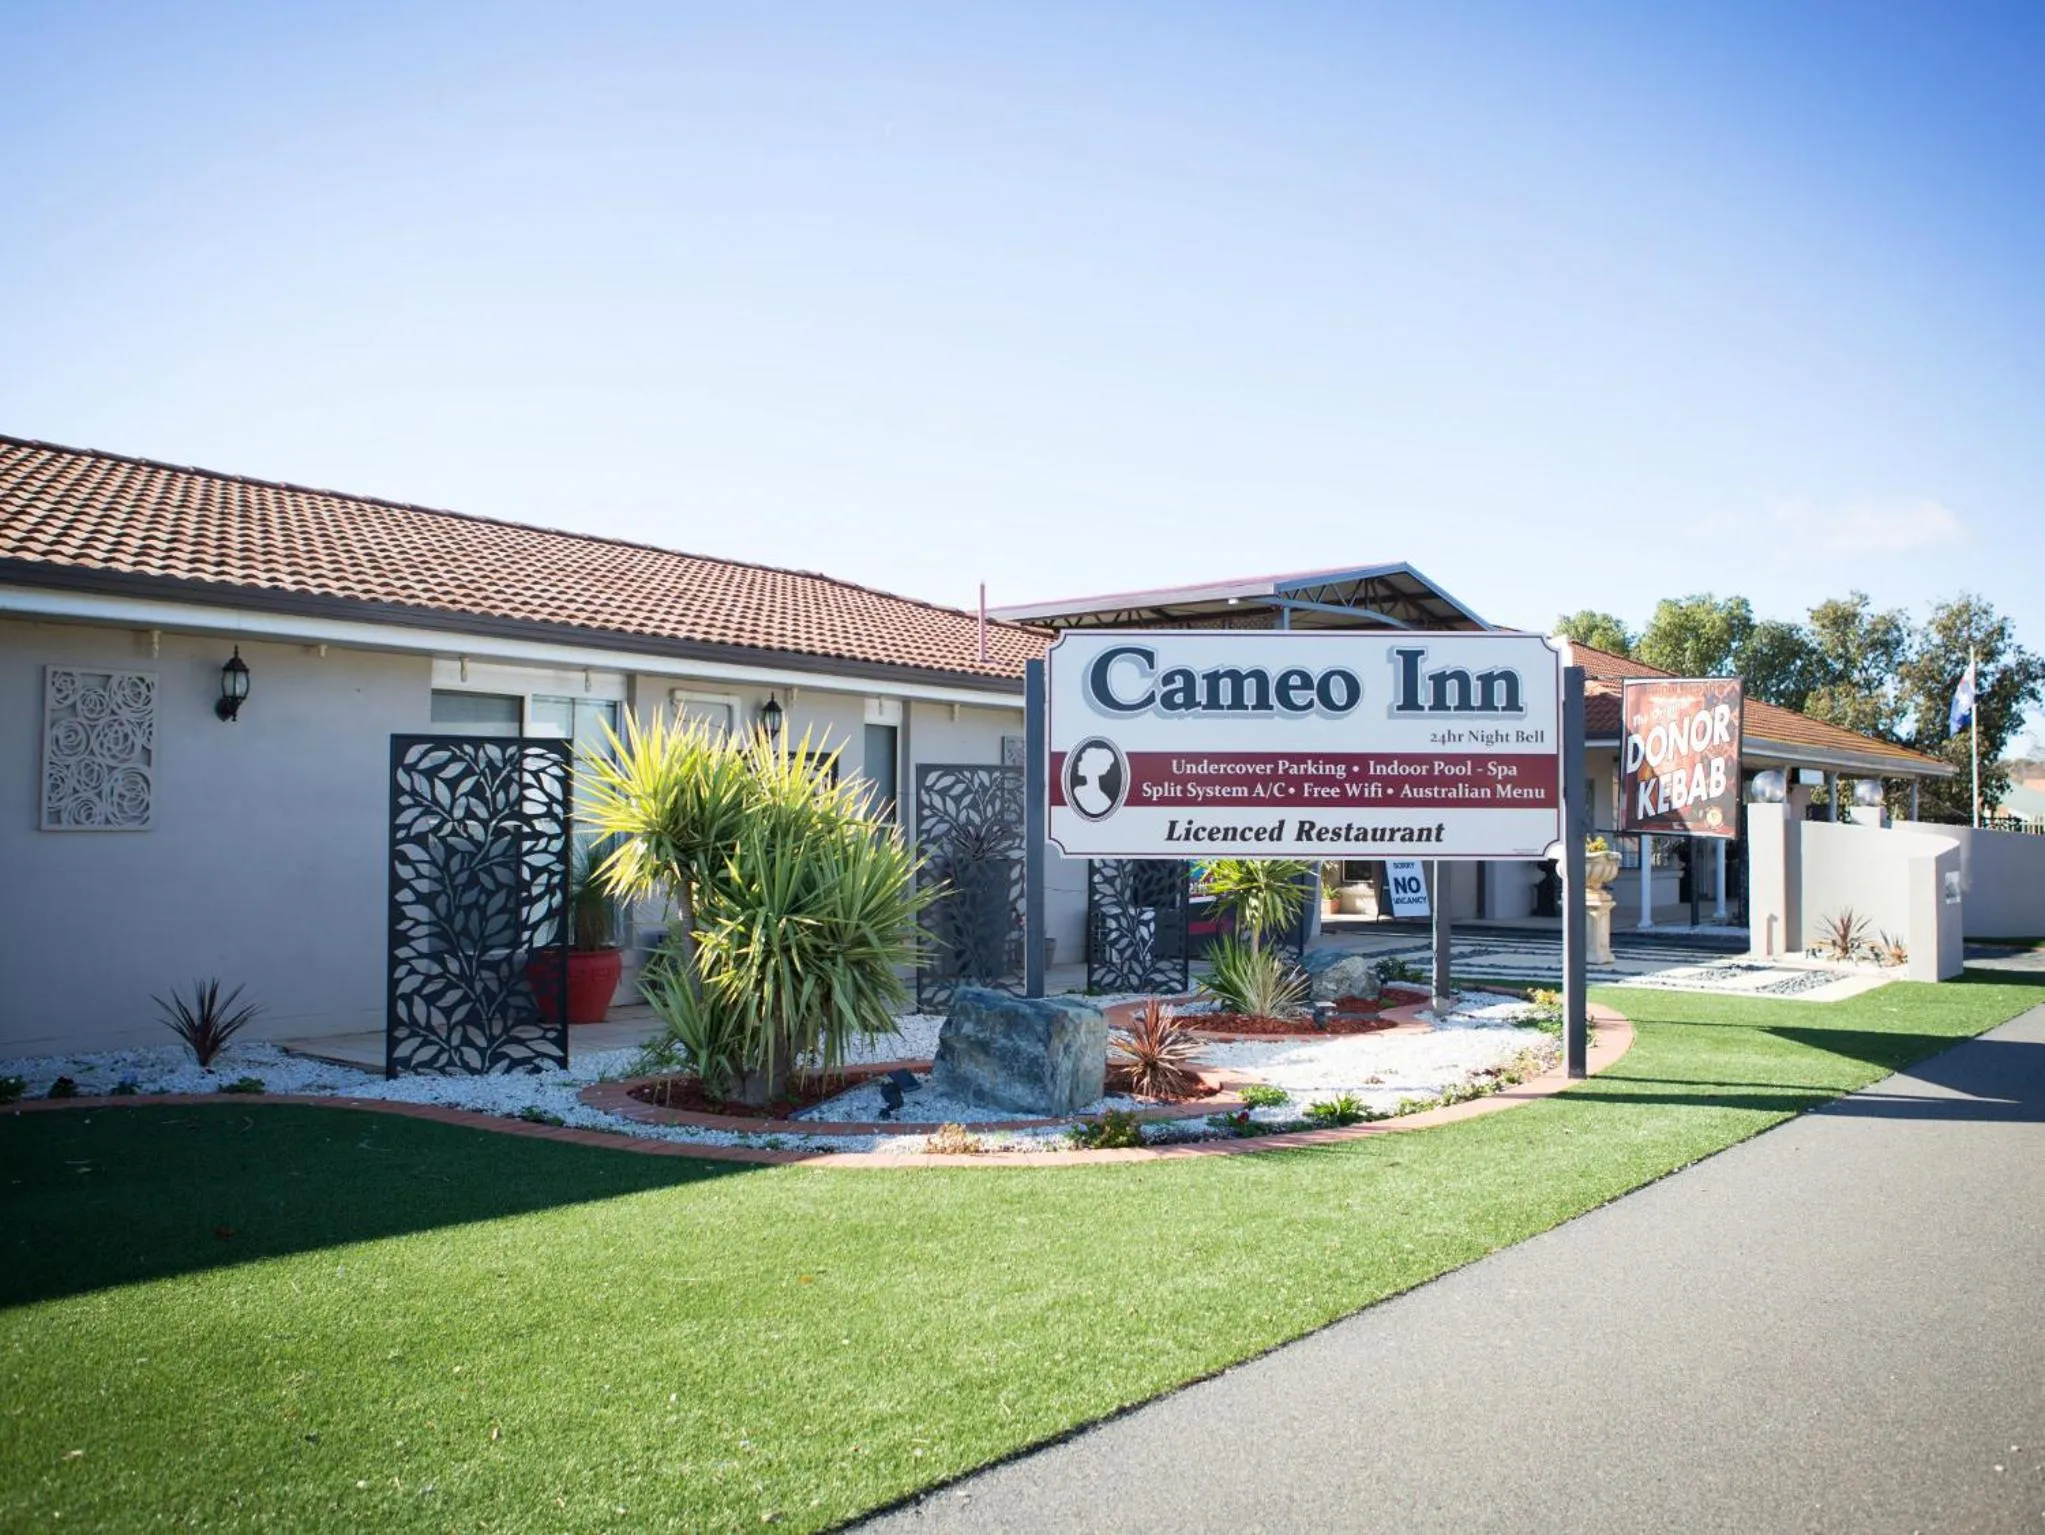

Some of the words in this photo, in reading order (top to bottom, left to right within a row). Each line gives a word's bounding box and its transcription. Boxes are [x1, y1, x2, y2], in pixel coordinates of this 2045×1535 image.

[1091, 648, 1360, 711] Cameo
[1396, 650, 1523, 712] Inn
[1430, 730, 1464, 745] 24hr
[1469, 730, 1511, 746] Night
[1516, 730, 1544, 743] Bell
[1627, 704, 1730, 773] DONOR
[1172, 759, 1274, 774] Undercover
[1278, 760, 1346, 779] Parking
[1369, 760, 1429, 775] Indoor
[1434, 760, 1471, 775] Pool
[1487, 761, 1517, 780] Spa
[1142, 781, 1183, 800] Split
[1187, 782, 1248, 800] System
[1253, 782, 1285, 798] A/C
[1303, 783, 1340, 797] Free
[1344, 782, 1382, 798] Wifi
[1400, 783, 1491, 798] Australian
[1496, 784, 1545, 798] Menu
[1637, 757, 1726, 820] KEBAB
[1165, 819, 1285, 842] Licenced
[1294, 820, 1445, 842] Restaurant
[1394, 876, 1421, 894] NO
